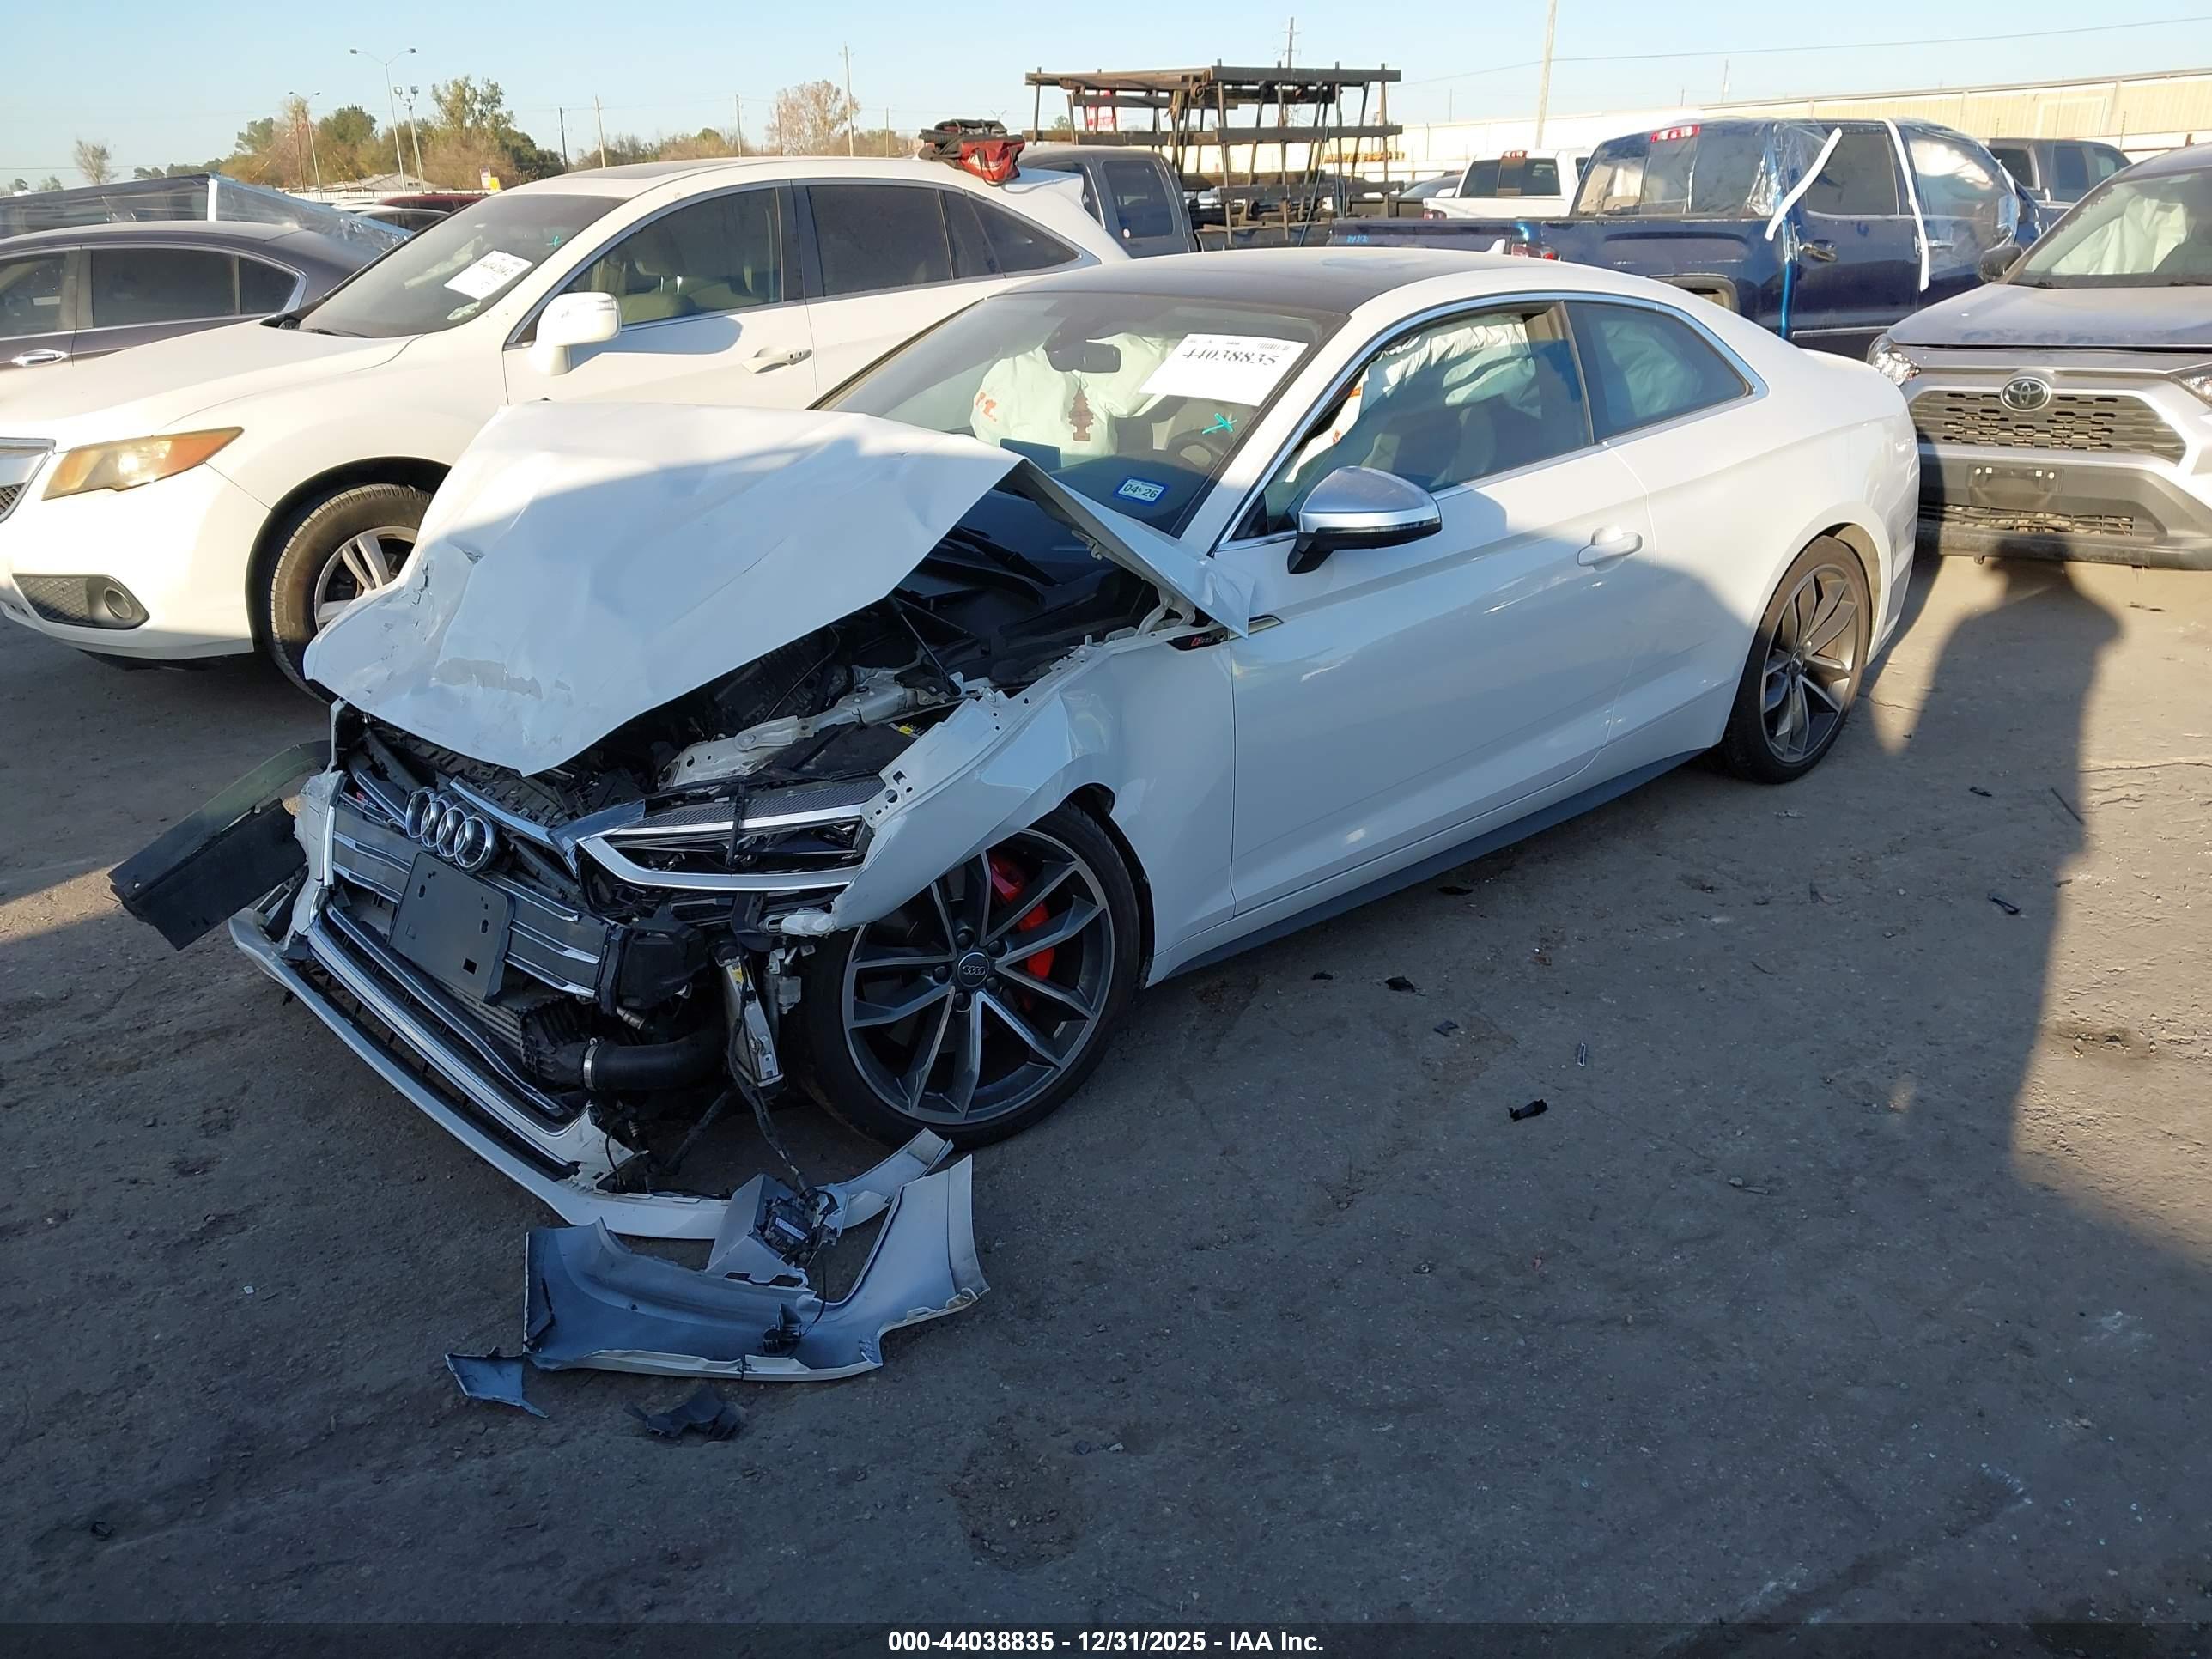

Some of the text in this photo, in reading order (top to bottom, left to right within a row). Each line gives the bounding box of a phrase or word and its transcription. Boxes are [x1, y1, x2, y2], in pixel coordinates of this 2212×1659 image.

[1182, 348, 1280, 366] 44038835
[1123, 484, 1139, 494] 04
[1142, 488, 1159, 498] 26
